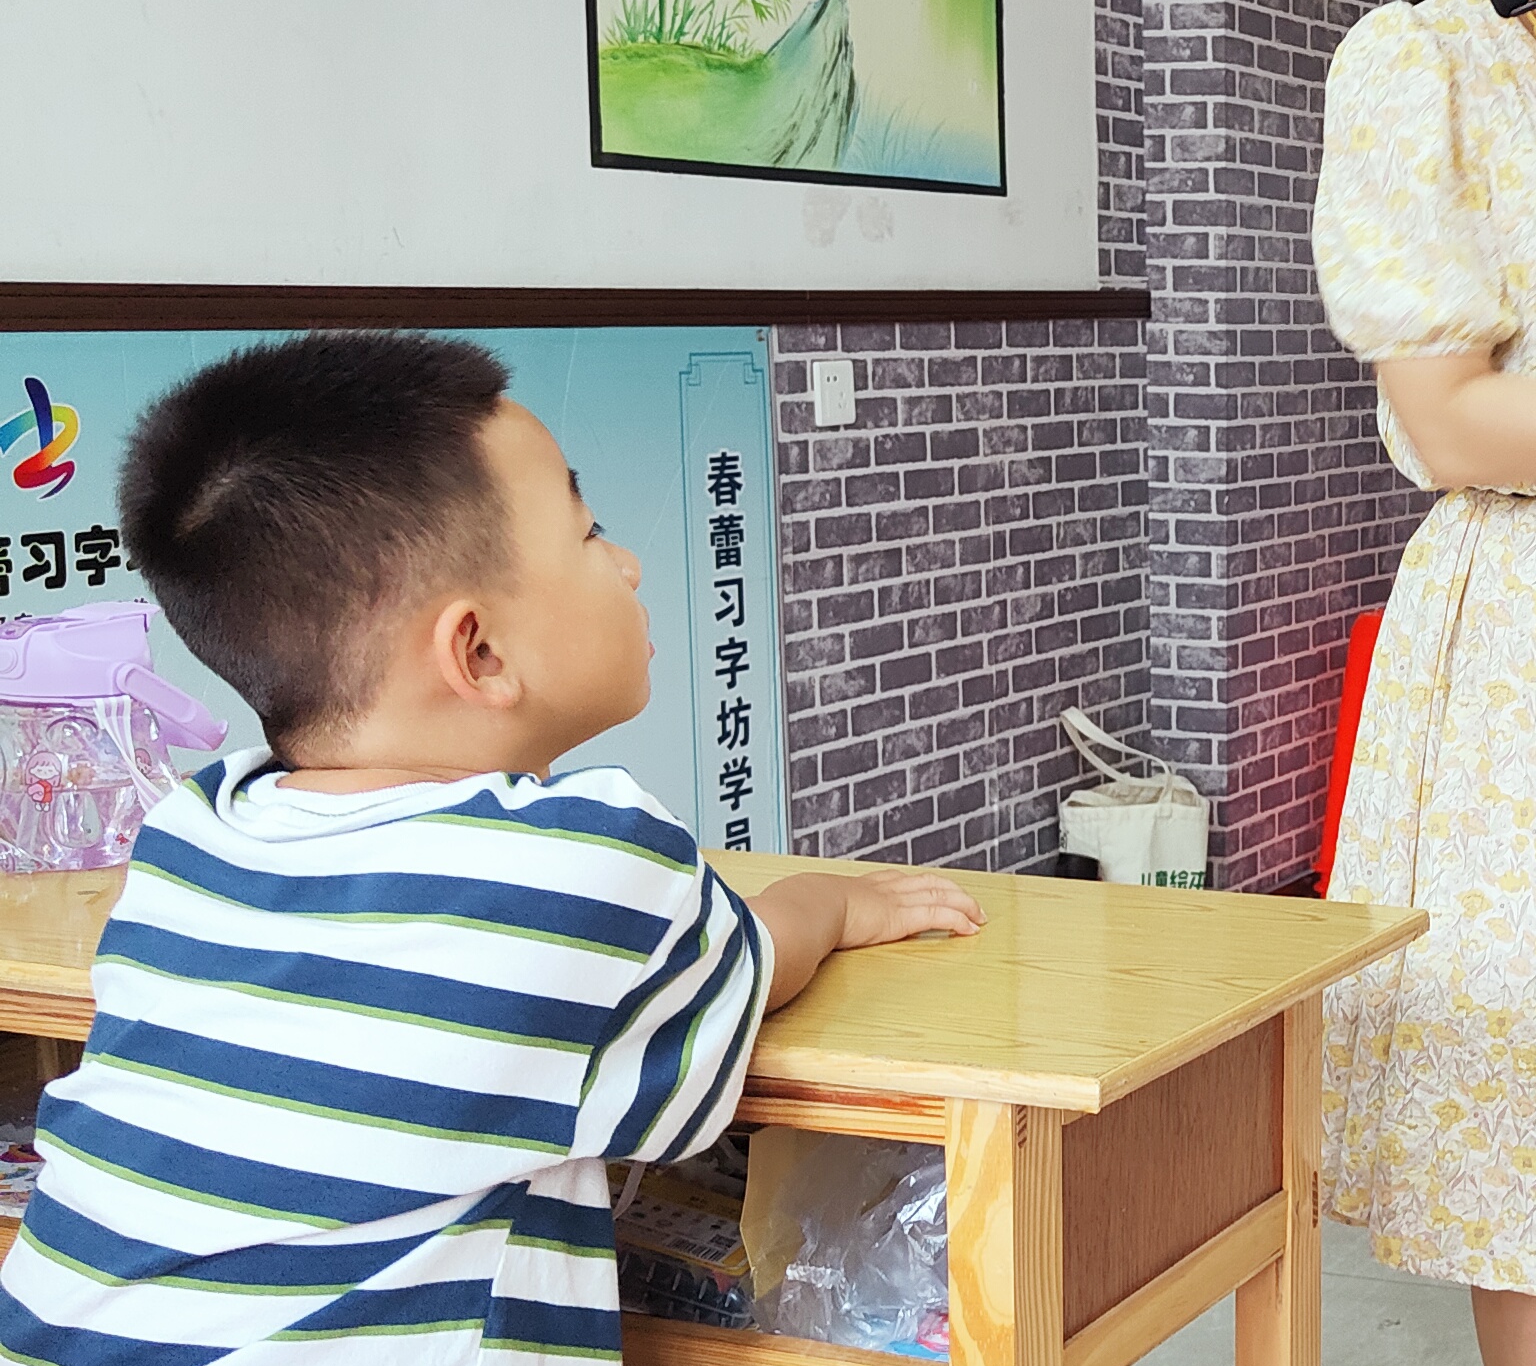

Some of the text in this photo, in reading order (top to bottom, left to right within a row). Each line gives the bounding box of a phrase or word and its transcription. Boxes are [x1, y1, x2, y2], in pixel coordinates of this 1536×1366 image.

[707, 451, 754, 852] 春蕾习字坊学员
